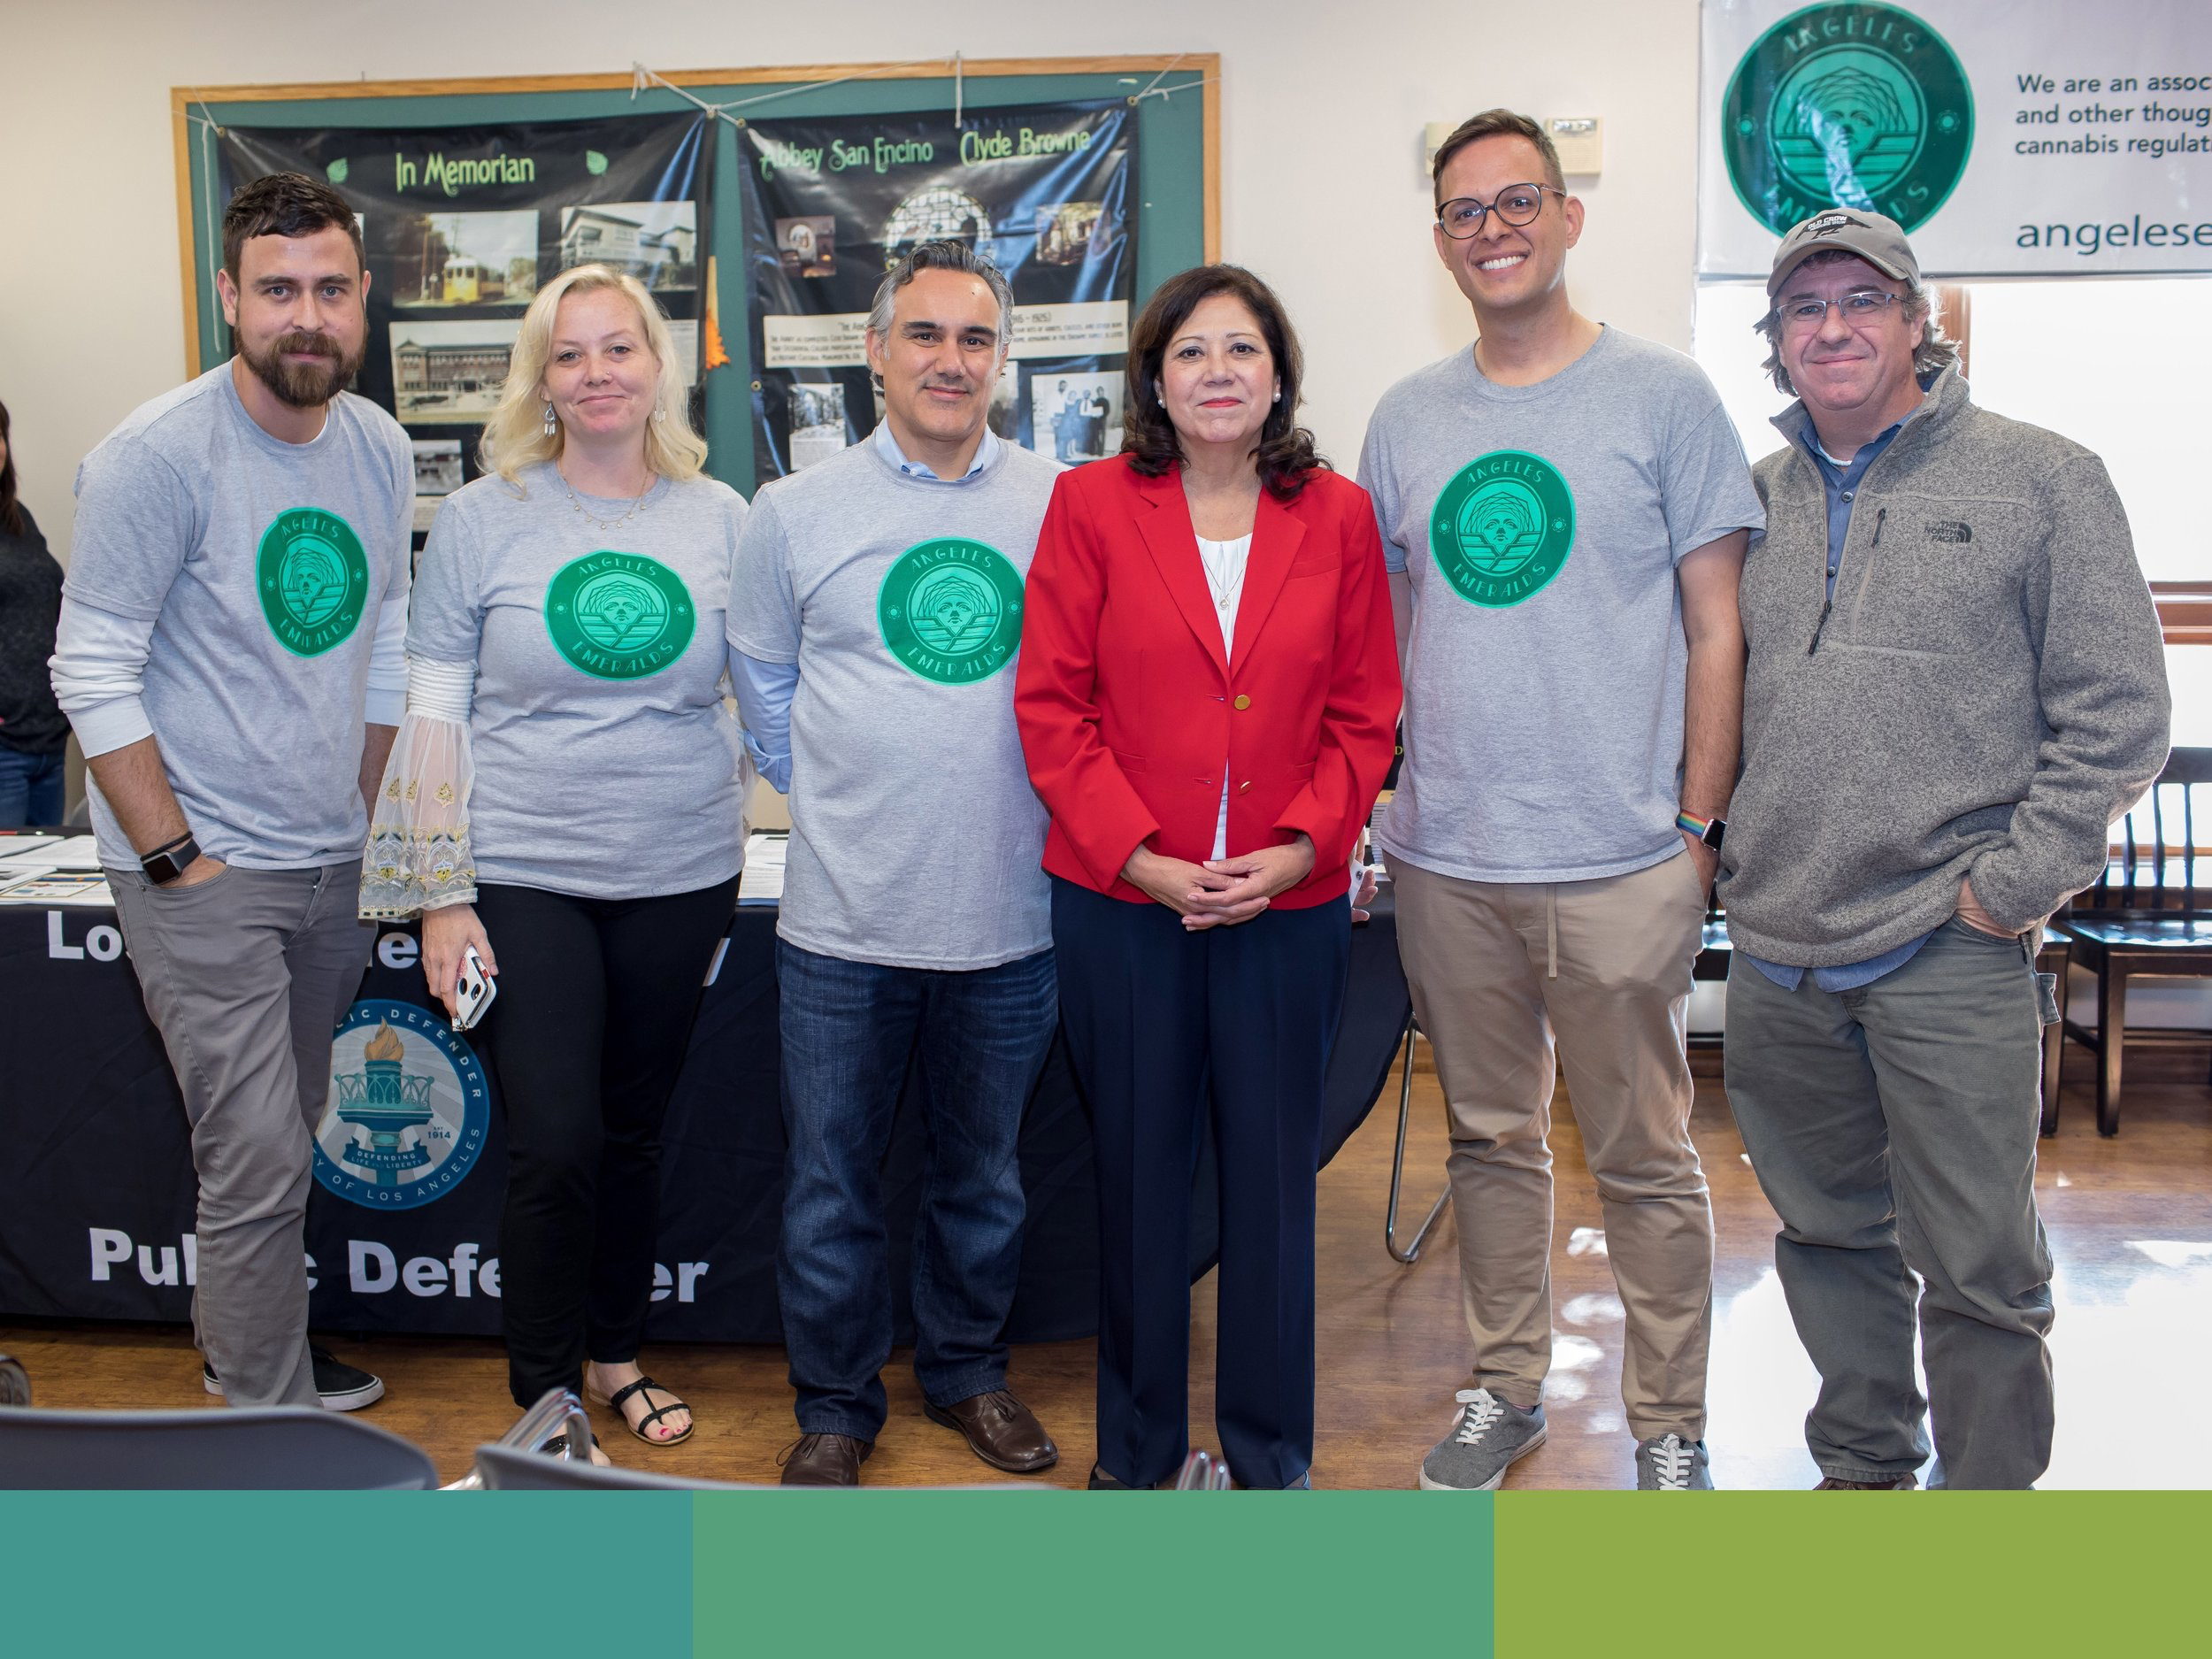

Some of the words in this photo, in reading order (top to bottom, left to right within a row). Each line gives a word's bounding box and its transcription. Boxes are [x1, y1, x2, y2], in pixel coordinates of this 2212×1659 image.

[1783, 15, 1920, 55] ANGELES
[2017, 73, 2055, 93] We
[2063, 78, 2101, 93] are
[2109, 77, 2138, 92] an
[2016, 104, 2059, 124] and
[2068, 103, 2134, 123] other
[2142, 101, 2211, 127] thoug
[759, 141, 823, 182] Abbey
[828, 138, 869, 172] San
[874, 136, 933, 173] Encino
[960, 130, 1011, 167] Clyde
[1018, 127, 1091, 157] Browne
[2015, 134, 2119, 154] cannabis
[396, 152, 417, 193] In
[423, 151, 534, 197] Memorian
[1808, 219, 1823, 229] OLD
[1824, 215, 1847, 224] CROW
[2016, 214, 2212, 256] angelese
[1466, 460, 1545, 487] ANGELES
[1924, 526, 1956, 535] NORTH
[579, 557, 658, 578] ANGELES
[911, 547, 994, 572] ANGELES
[1453, 562, 1546, 597] EMERALDS
[572, 641, 673, 672] EMERALDS
[907, 641, 1006, 676] EMERALDS
[48, 910, 131, 961] Lo
[390, 1009, 481, 1099] DEFENDER
[332, 1174, 355, 1190] OF
[366, 1189, 403, 1202] LOS
[417, 1128, 480, 1196] ANGELES
[357, 1150, 416, 1161] DEFENDING
